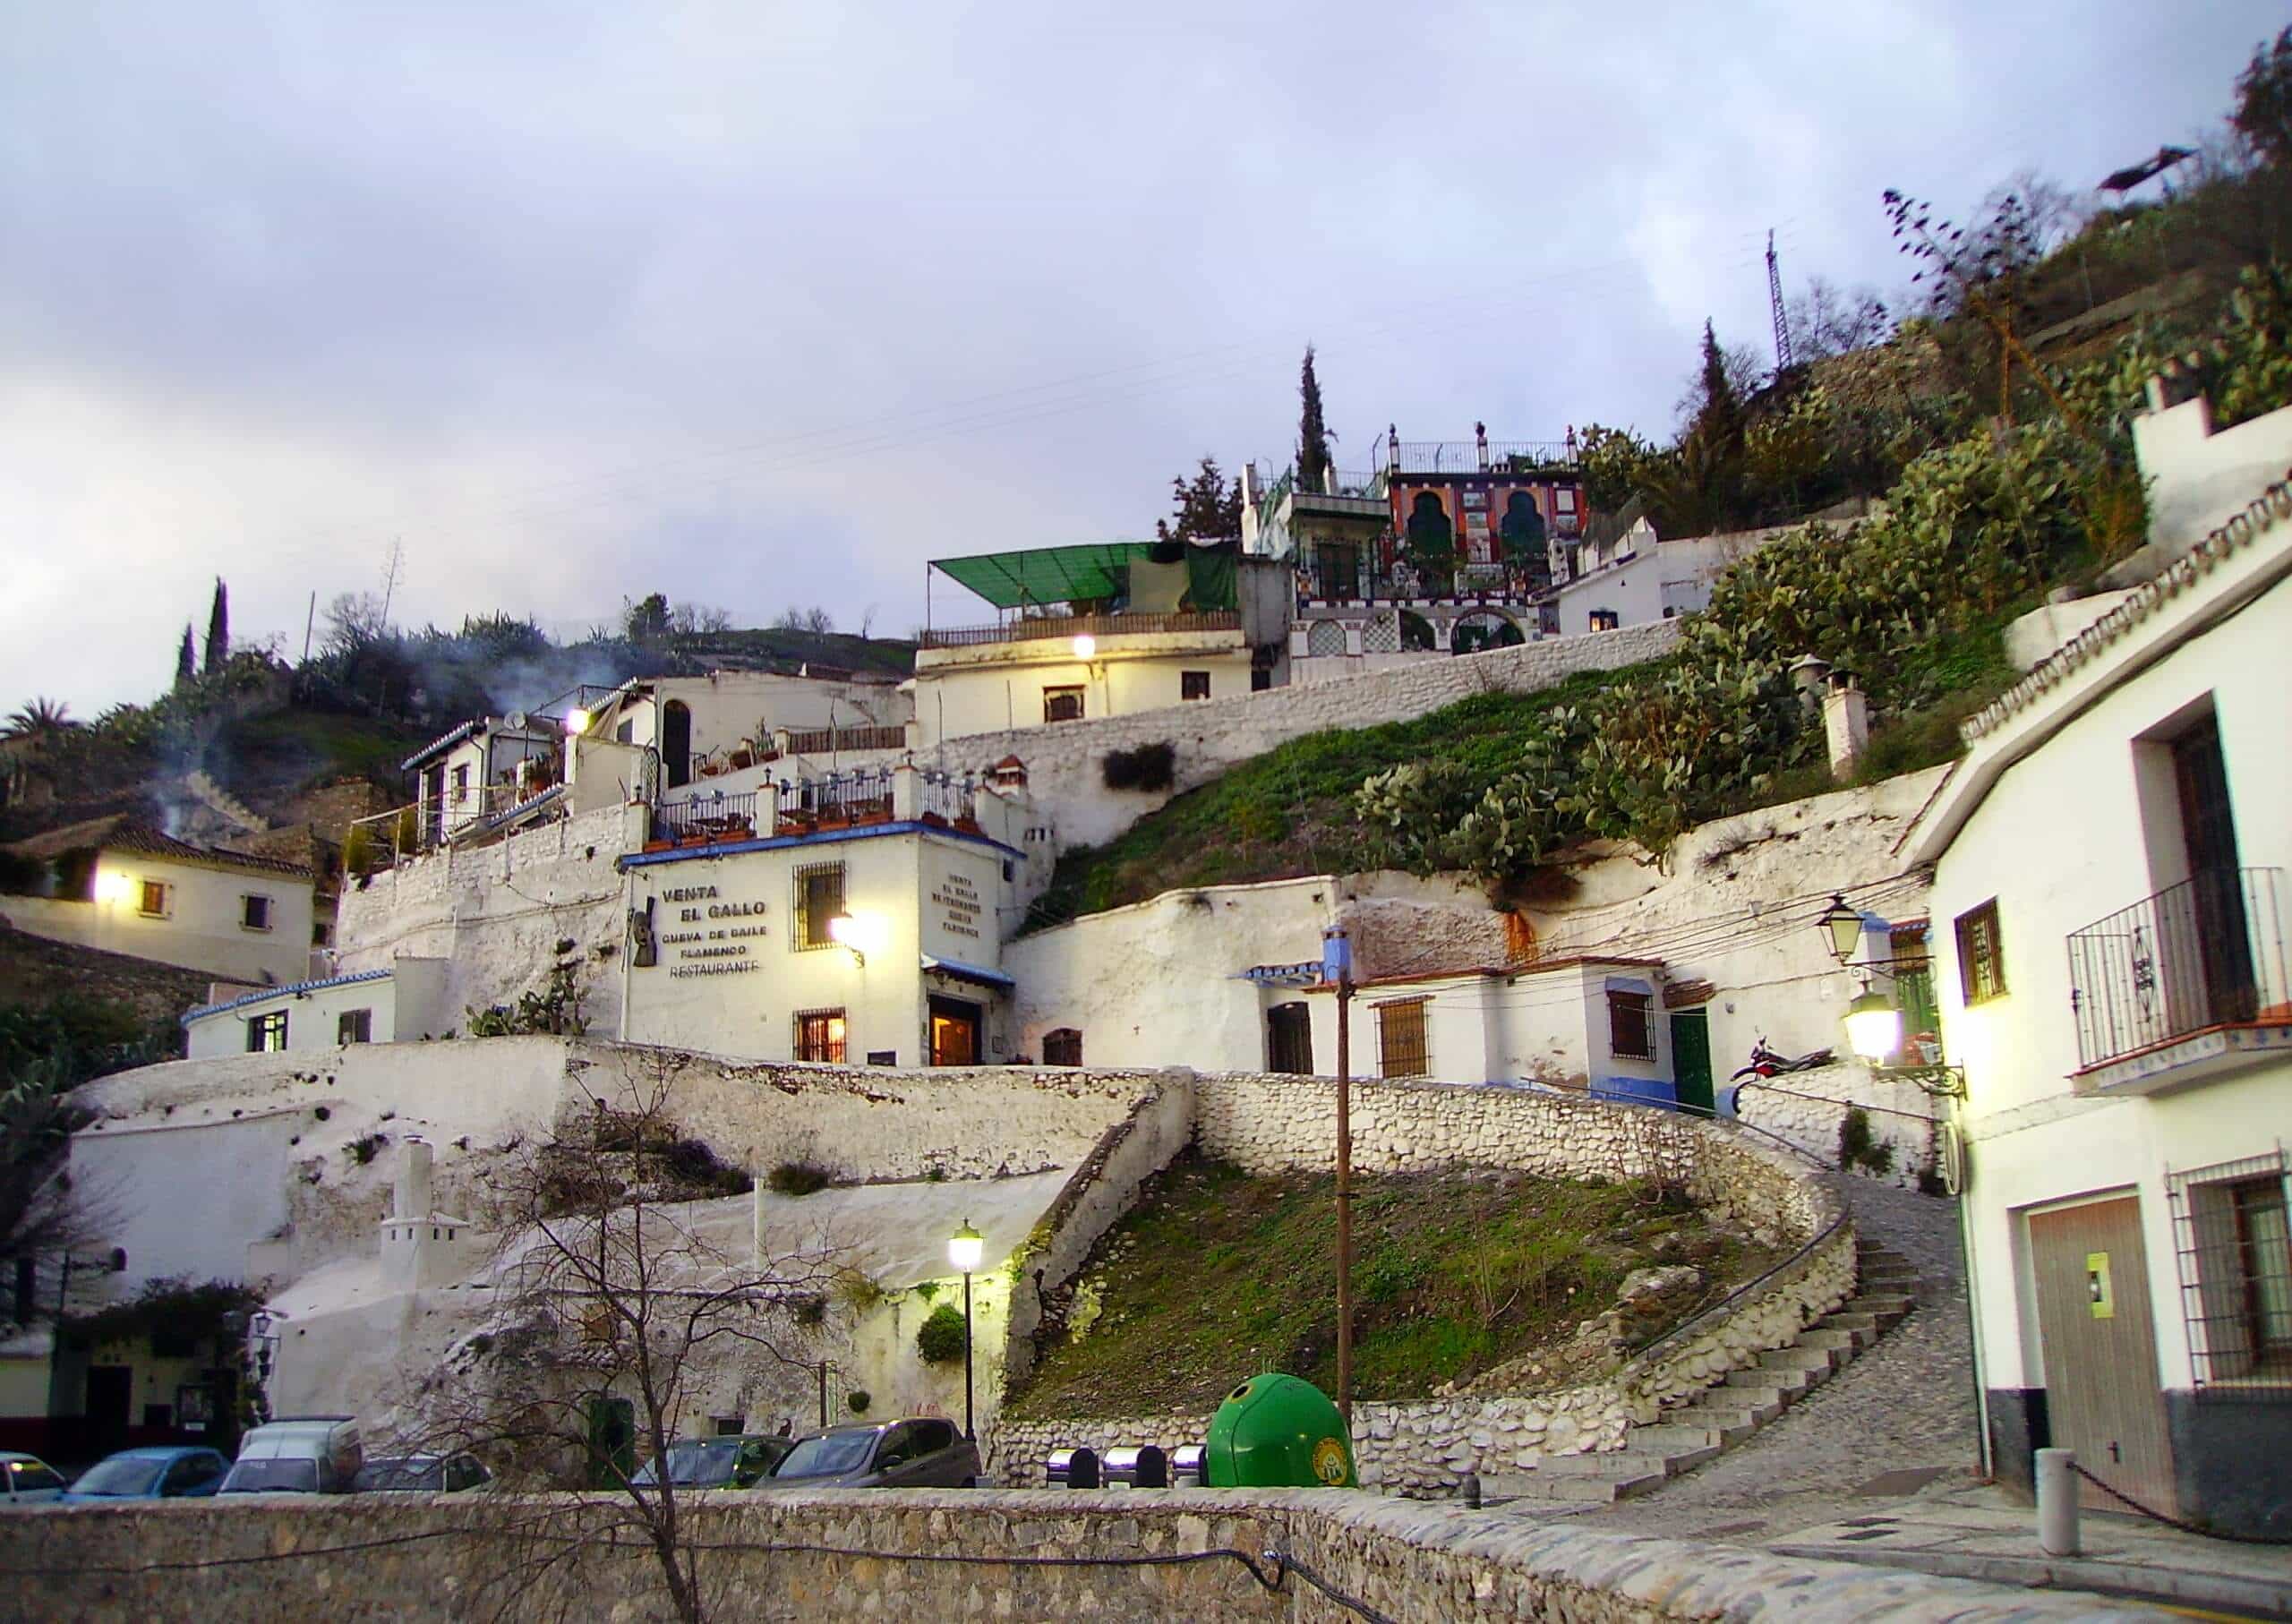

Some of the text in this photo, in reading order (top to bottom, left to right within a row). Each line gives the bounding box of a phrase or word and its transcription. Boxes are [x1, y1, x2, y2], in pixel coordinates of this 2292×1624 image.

[663, 885, 718, 902] VENTA
[680, 902, 765, 922] EL GALLO
[663, 926, 767, 944] CUEVA DE BAILE
[680, 945, 747, 959] FLAMENCO
[670, 960, 760, 979] RESTAURANTE
